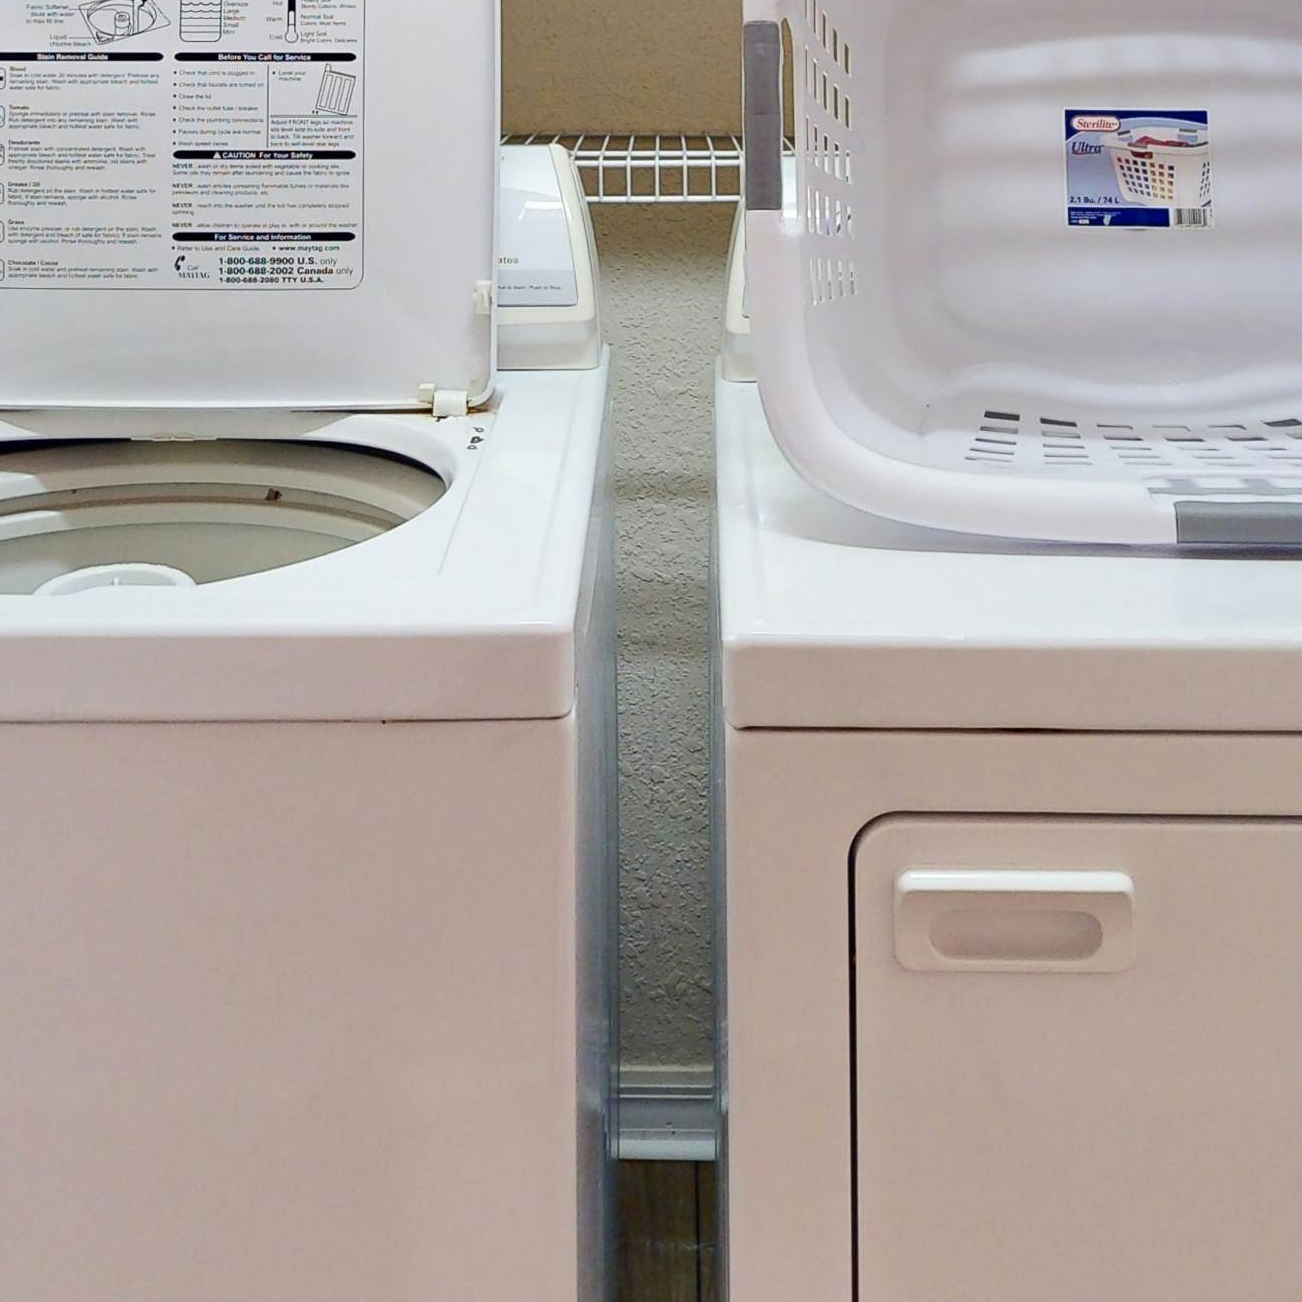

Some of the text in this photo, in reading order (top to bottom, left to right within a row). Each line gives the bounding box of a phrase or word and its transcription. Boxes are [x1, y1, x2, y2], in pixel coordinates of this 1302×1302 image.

[1076, 118, 1115, 129] Sterilite
[1071, 142, 1102, 154] Ultra
[223, 152, 313, 160] CAUTION For Your Safety
[219, 257, 337, 266] 1-800-688-9900 U.S. only
[219, 267, 354, 276] 1-800-688-2002 Canada only
